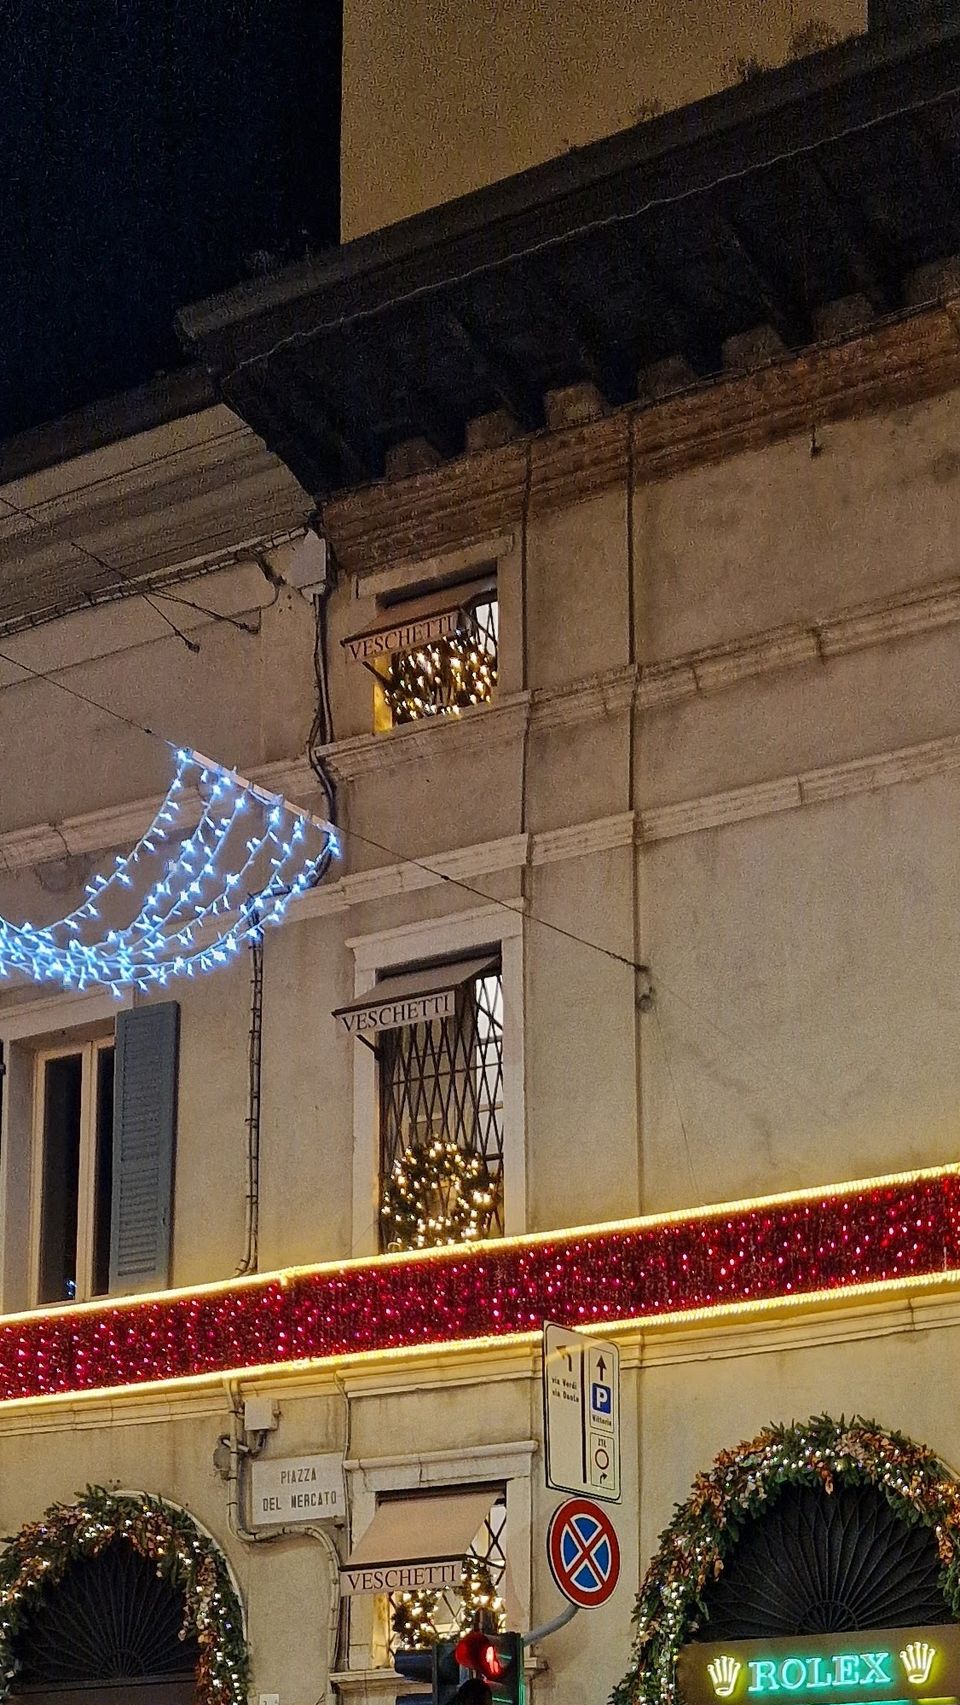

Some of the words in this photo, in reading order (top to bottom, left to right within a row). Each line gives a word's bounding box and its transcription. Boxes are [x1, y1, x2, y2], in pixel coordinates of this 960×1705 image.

[349, 615, 453, 659] VESCHETTI
[342, 994, 449, 1031] VESCHETTI
[281, 1467, 317, 1484] PIAZZA
[262, 1497, 282, 1511] DEL
[291, 1491, 337, 1508] MERCATO
[347, 1565, 456, 1590] VESCHETTI
[747, 1652, 891, 1693] ROLEX
